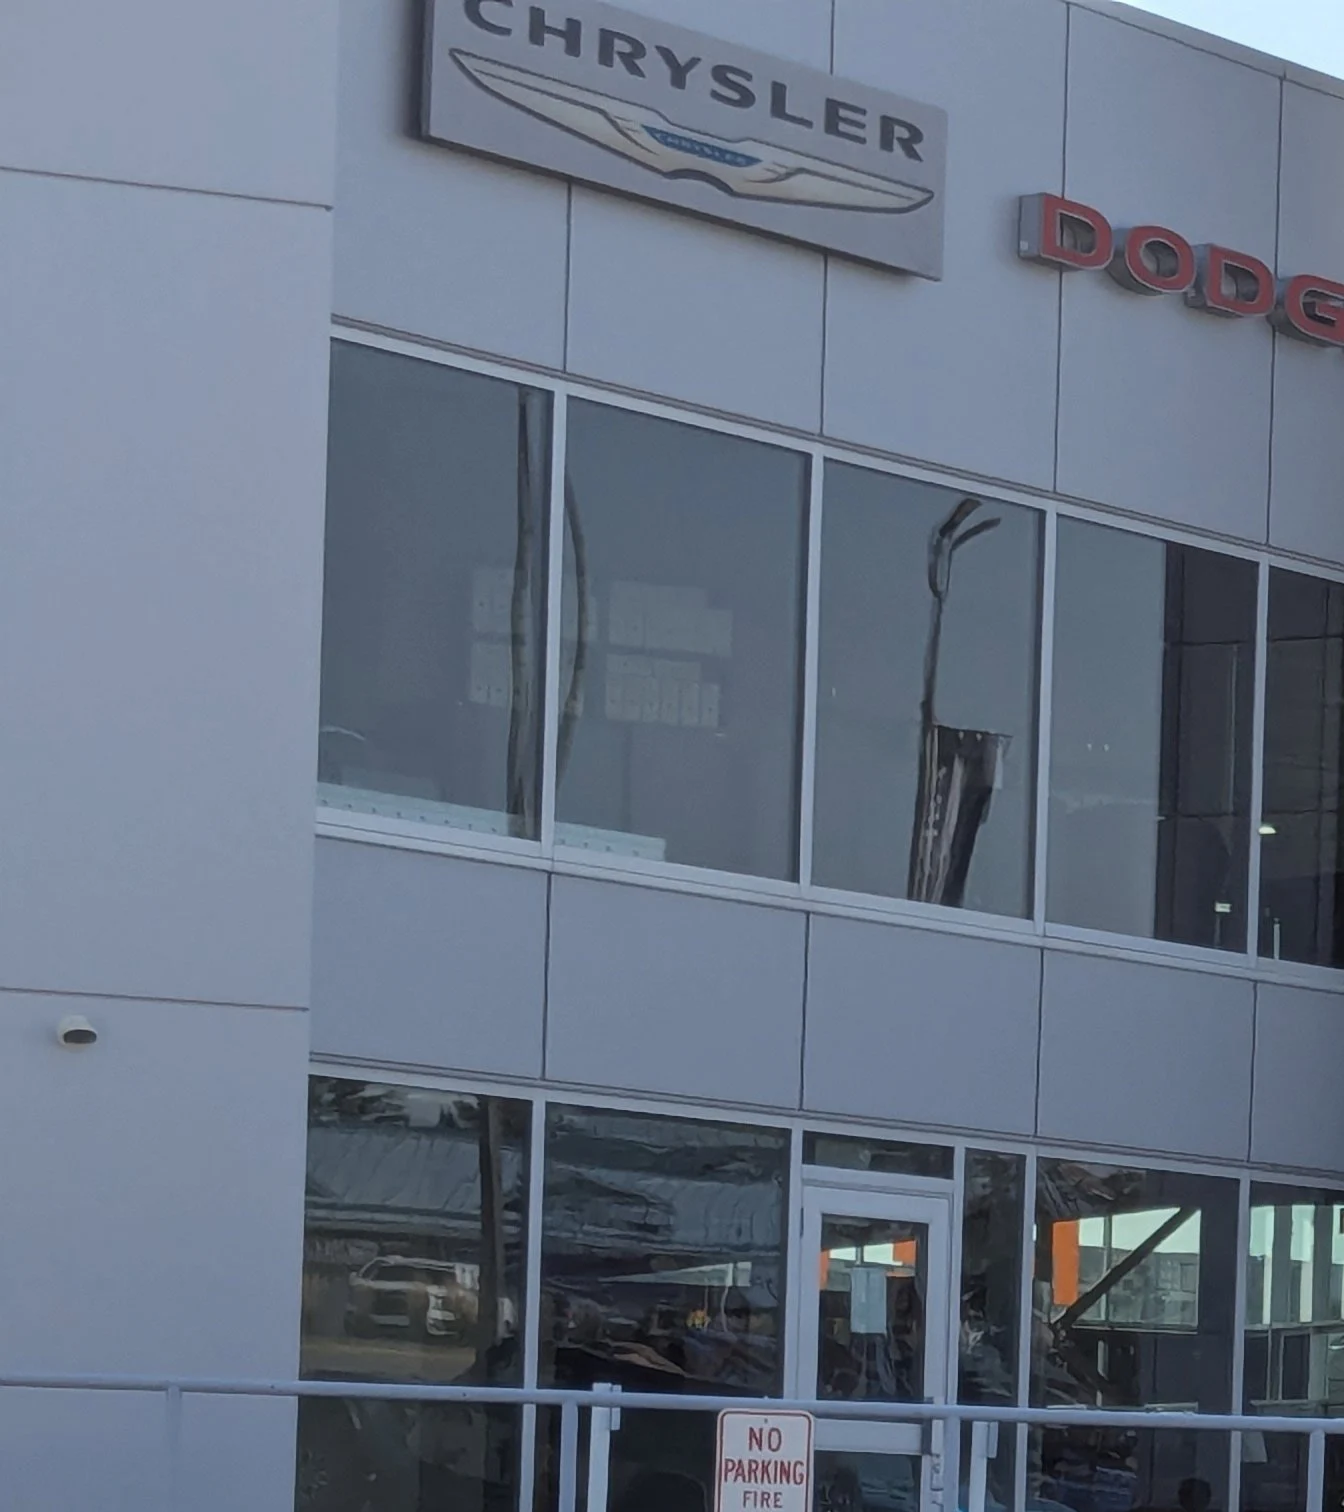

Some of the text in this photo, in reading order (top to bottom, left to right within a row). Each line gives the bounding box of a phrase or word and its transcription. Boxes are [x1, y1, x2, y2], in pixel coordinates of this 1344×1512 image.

[463, 0, 925, 163] CHRYSLER
[748, 1426, 783, 1452] NO
[723, 1458, 805, 1486] PARKING
[742, 1490, 784, 1509] FIRE
